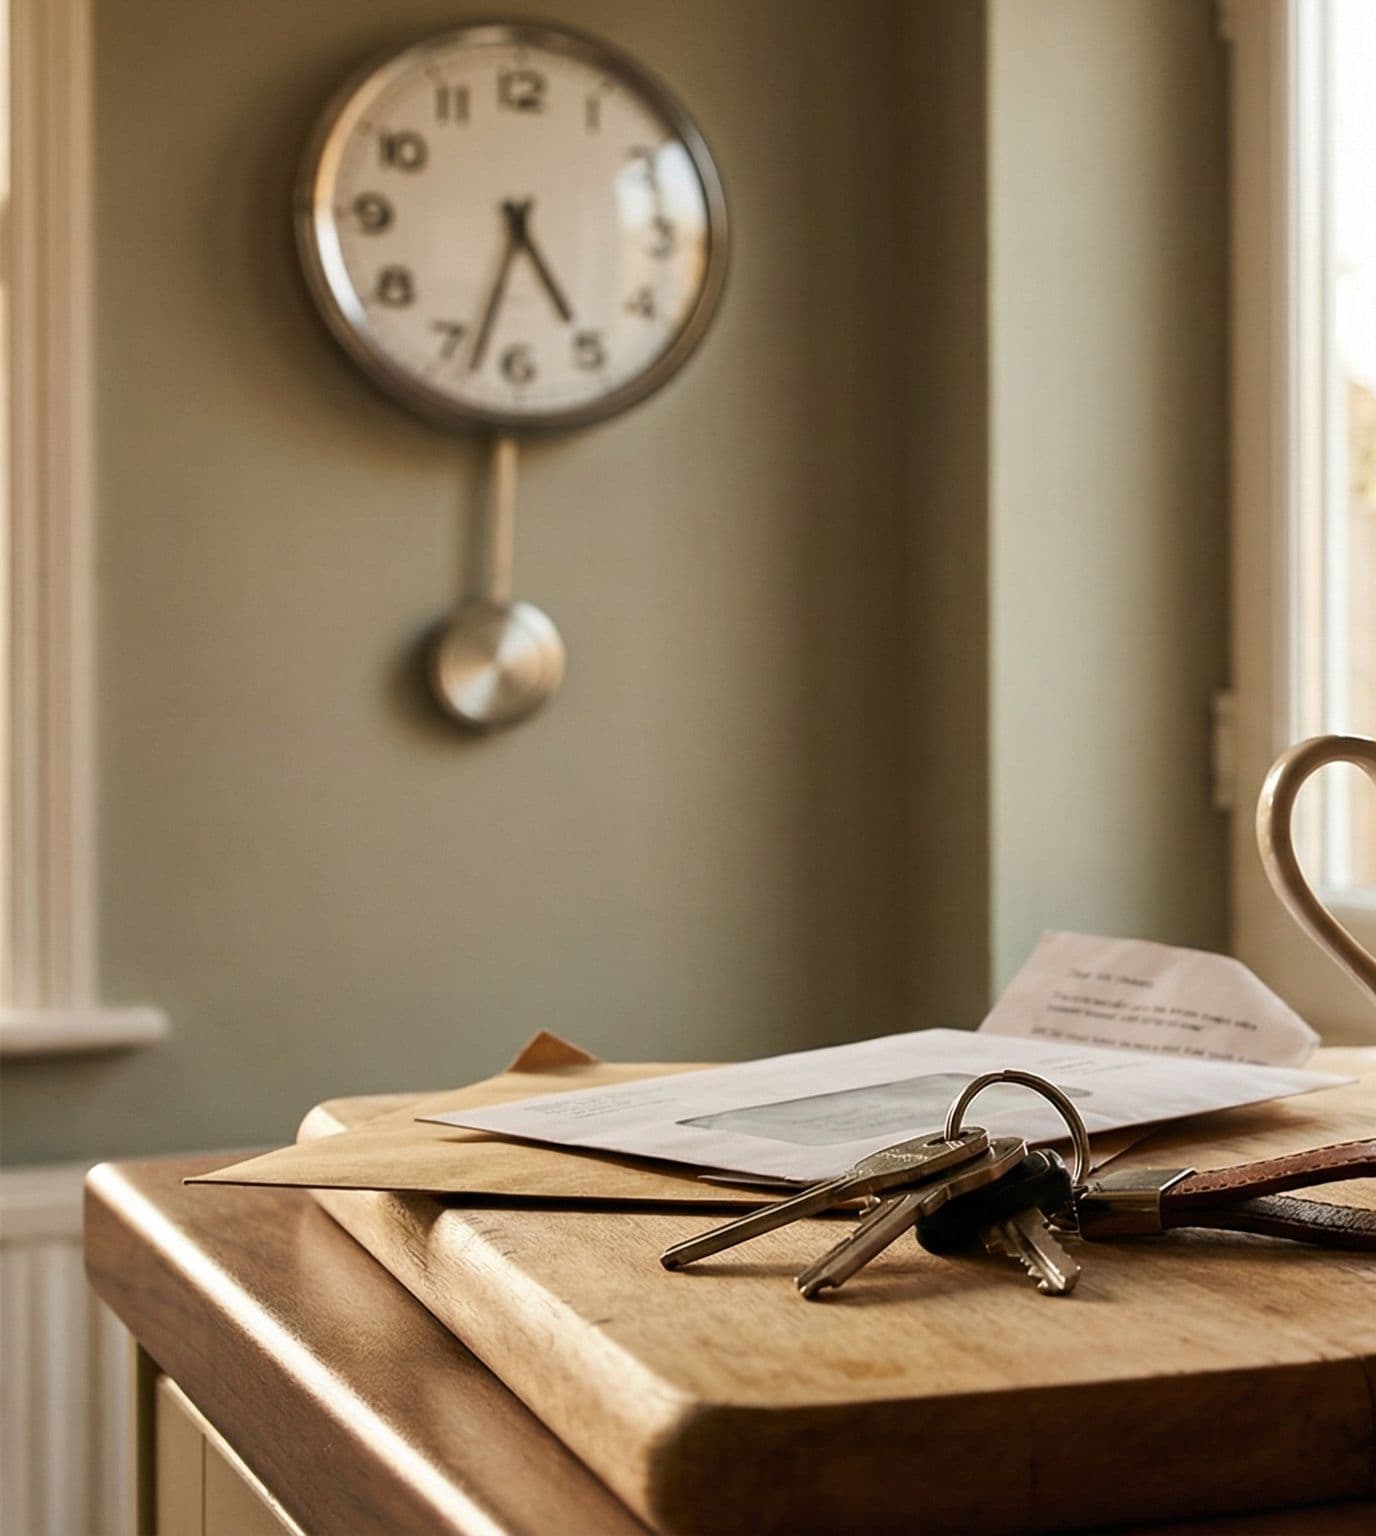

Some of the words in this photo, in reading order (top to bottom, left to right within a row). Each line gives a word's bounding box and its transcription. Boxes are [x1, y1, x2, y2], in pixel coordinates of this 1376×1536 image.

[436, 85, 469, 124] 11
[500, 69, 548, 115] 12
[381, 132, 428, 174] 10
[354, 194, 393, 235] 9
[375, 265, 415, 308] 8
[429, 320, 466, 361] 7
[573, 330, 603, 371] 5
[502, 345, 537, 385] 6
